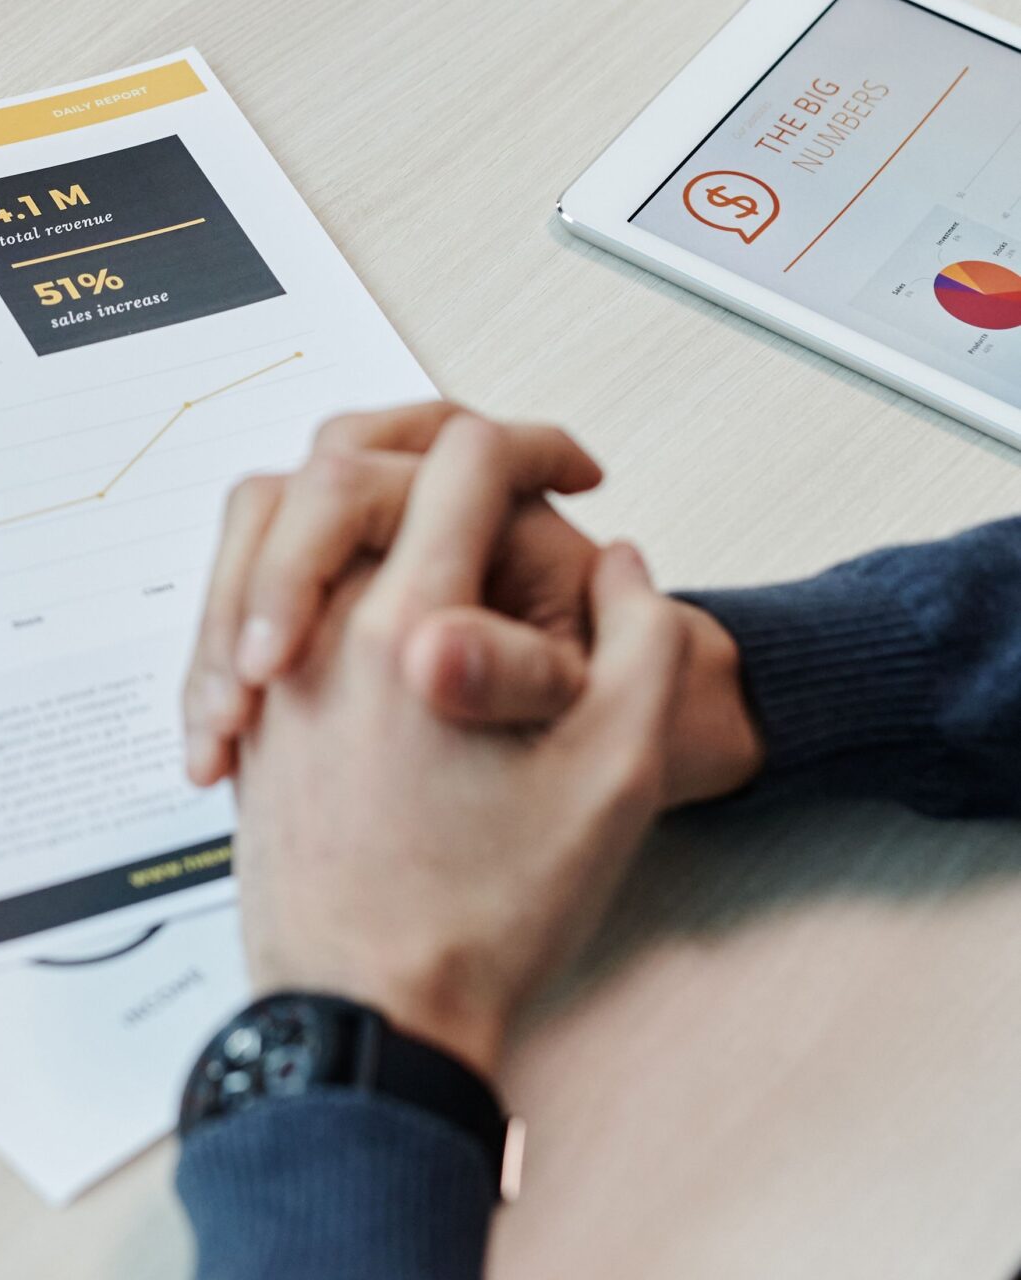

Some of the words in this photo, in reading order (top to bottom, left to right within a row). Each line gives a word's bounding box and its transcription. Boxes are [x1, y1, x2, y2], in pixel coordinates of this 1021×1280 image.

[52, 101, 92, 118] DAILY
[94, 86, 149, 108] REPORT
[755, 113, 807, 154] THE
[792, 78, 841, 115] BIG
[791, 79, 890, 174] NUMBERS
[48, 184, 91, 211] M
[0, 226, 41, 247] total
[45, 213, 114, 237] revenue
[33, 268, 124, 306] 51%
[50, 304, 93, 329] sales
[96, 290, 170, 318] increase
